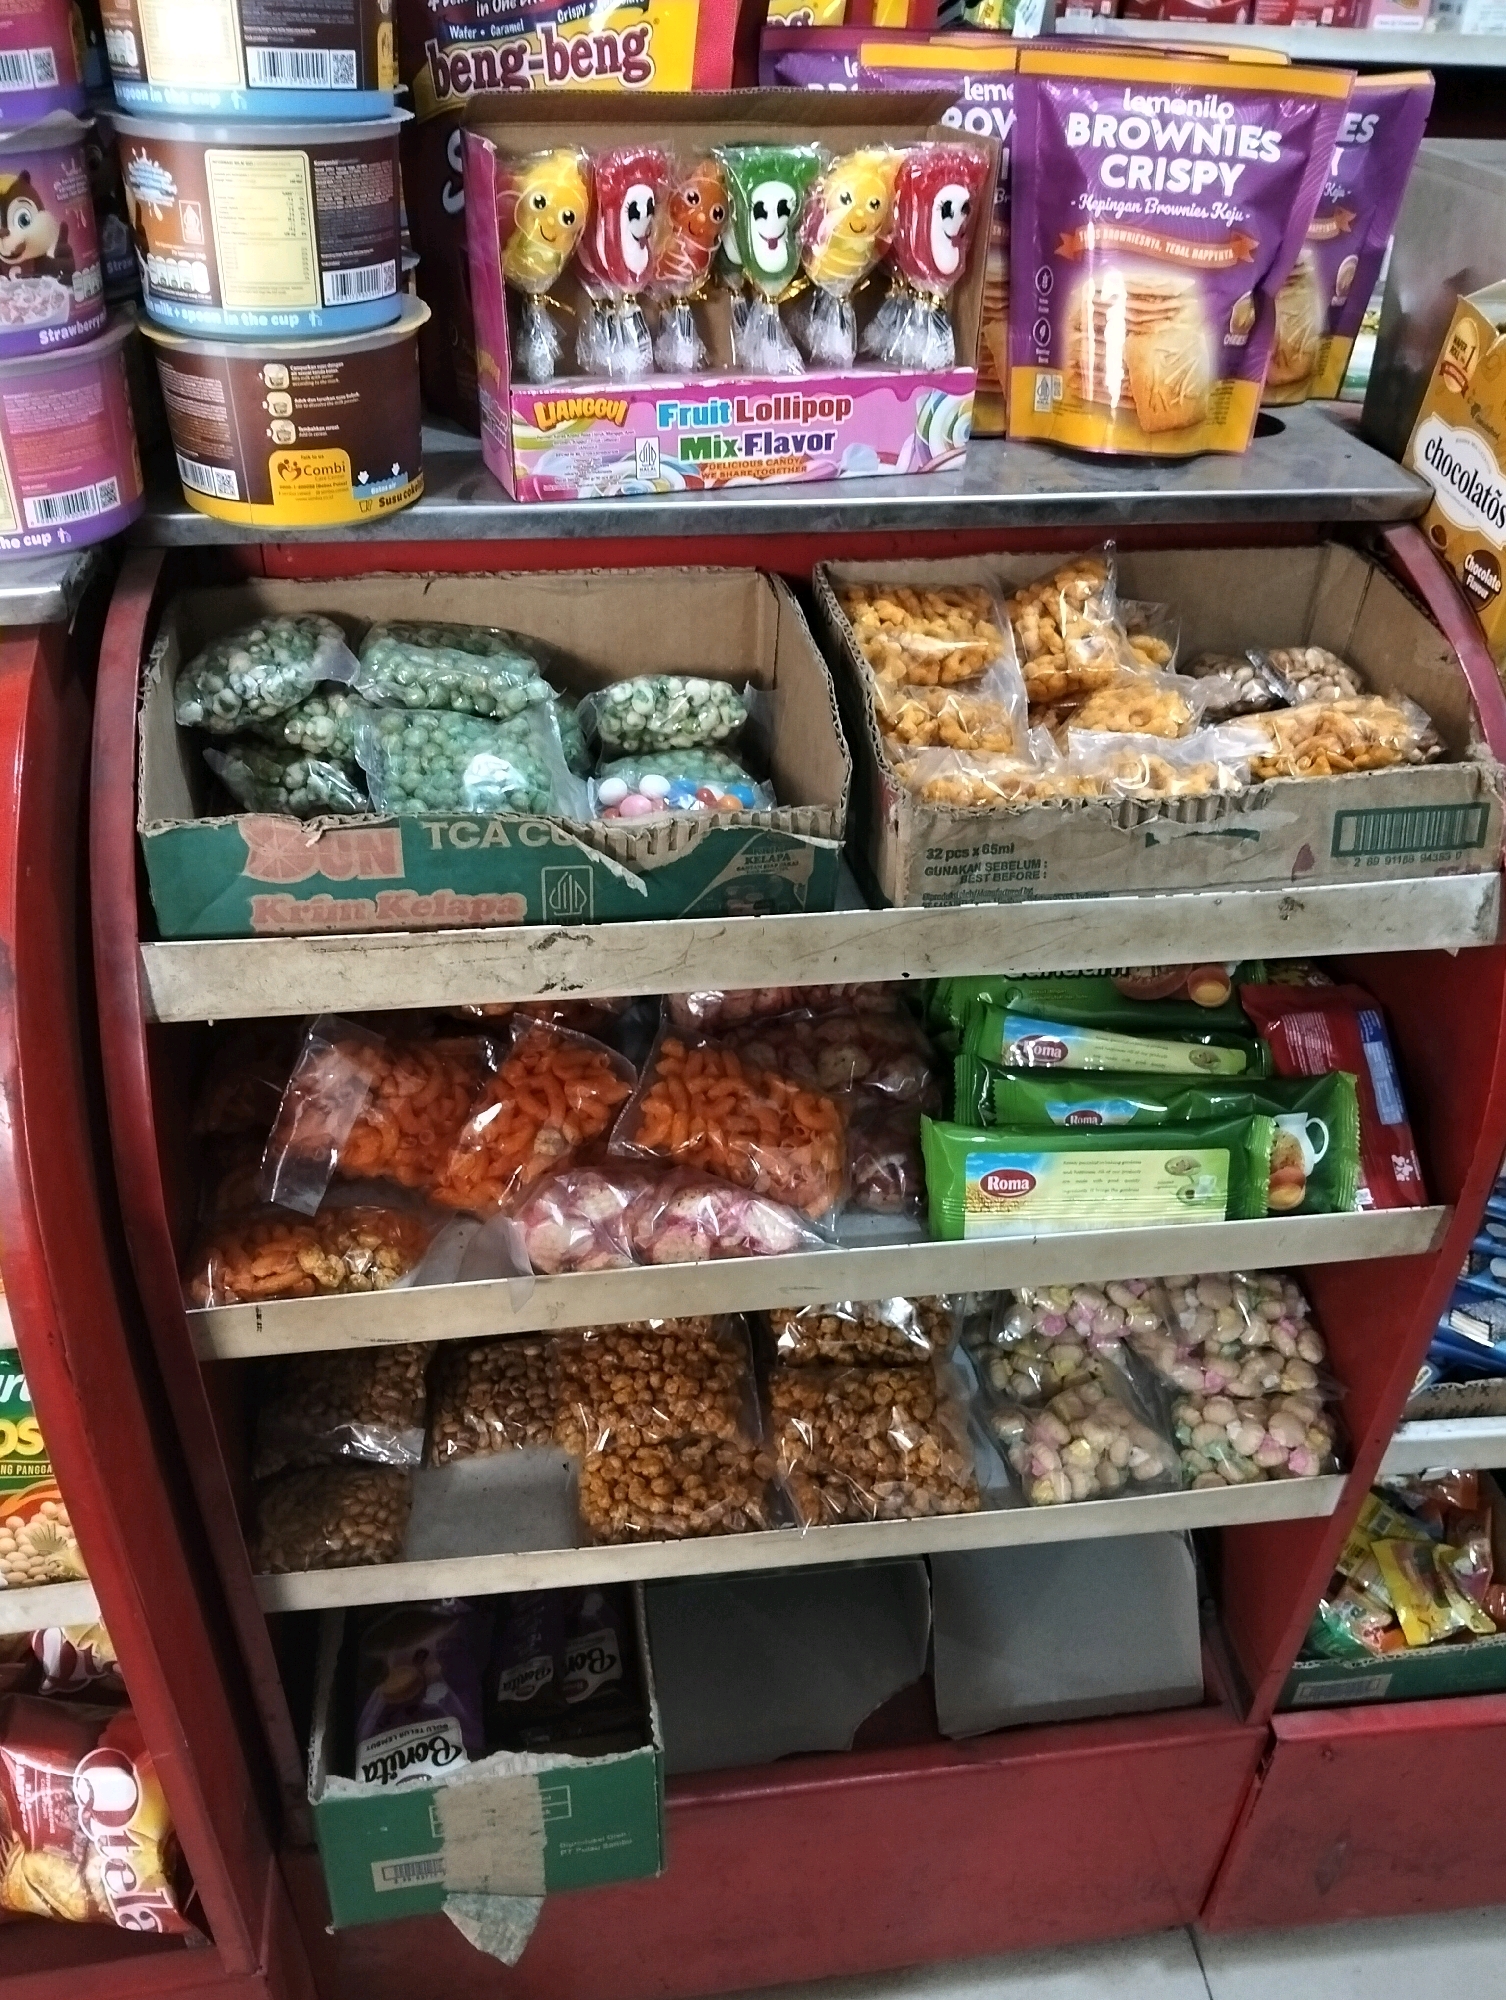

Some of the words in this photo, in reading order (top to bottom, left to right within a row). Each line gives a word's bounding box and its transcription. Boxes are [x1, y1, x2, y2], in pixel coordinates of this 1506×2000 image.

[449, 25, 477, 39] Wafer
[490, 18, 525, 37] Caramel
[557, 1, 587, 23] Crispy
[425, 21, 656, 100] beng-beng
[1122, 87, 1235, 126] lemonilo
[1065, 112, 1283, 163] BROWNIES
[1100, 153, 1246, 197] CRISPY
[1079, 194, 1142, 220] Kepingan
[1144, 197, 1210, 219] Brownies
[1210, 201, 1244, 227] Keju
[181, 309, 222, 325] spoon
[223, 310, 240, 326] in
[240, 312, 268, 327] the
[271, 314, 300, 328] cup
[656, 398, 733, 431] Fruit
[734, 392, 854, 426] Lollipop
[303, 460, 346, 476] Combi
[708, 458, 764, 470] DELICIOUS
[719, 469, 754, 478] SHARE
[755, 465, 808, 477] TOGETHER
[379, 491, 403, 508] Susu
[24, 532, 52, 547] cup
[1464, 553, 1502, 594] Chocolate
[1466, 575, 1490, 600] Flavour
[745, 852, 792, 865] KELAPA
[926, 848, 943, 860] 32
[945, 849, 970, 863] pcs
[972, 847, 980, 858] x
[981, 842, 1016, 856] 65ml
[925, 864, 982, 877] GUNAKAN
[984, 859, 1042, 872] SEBELUM
[1353, 858, 1361, 867] 2
[960, 873, 991, 885] BEST
[993, 870, 1041, 882] BEFORE
[252, 892, 371, 926] Krim
[375, 890, 522, 924] Kelapa
[1070, 1114, 1099, 1125] Roma
[987, 1175, 1031, 1191] Roma
[16, 1464, 52, 1476] PANGGA
[361, 1736, 463, 1785] Bonita
